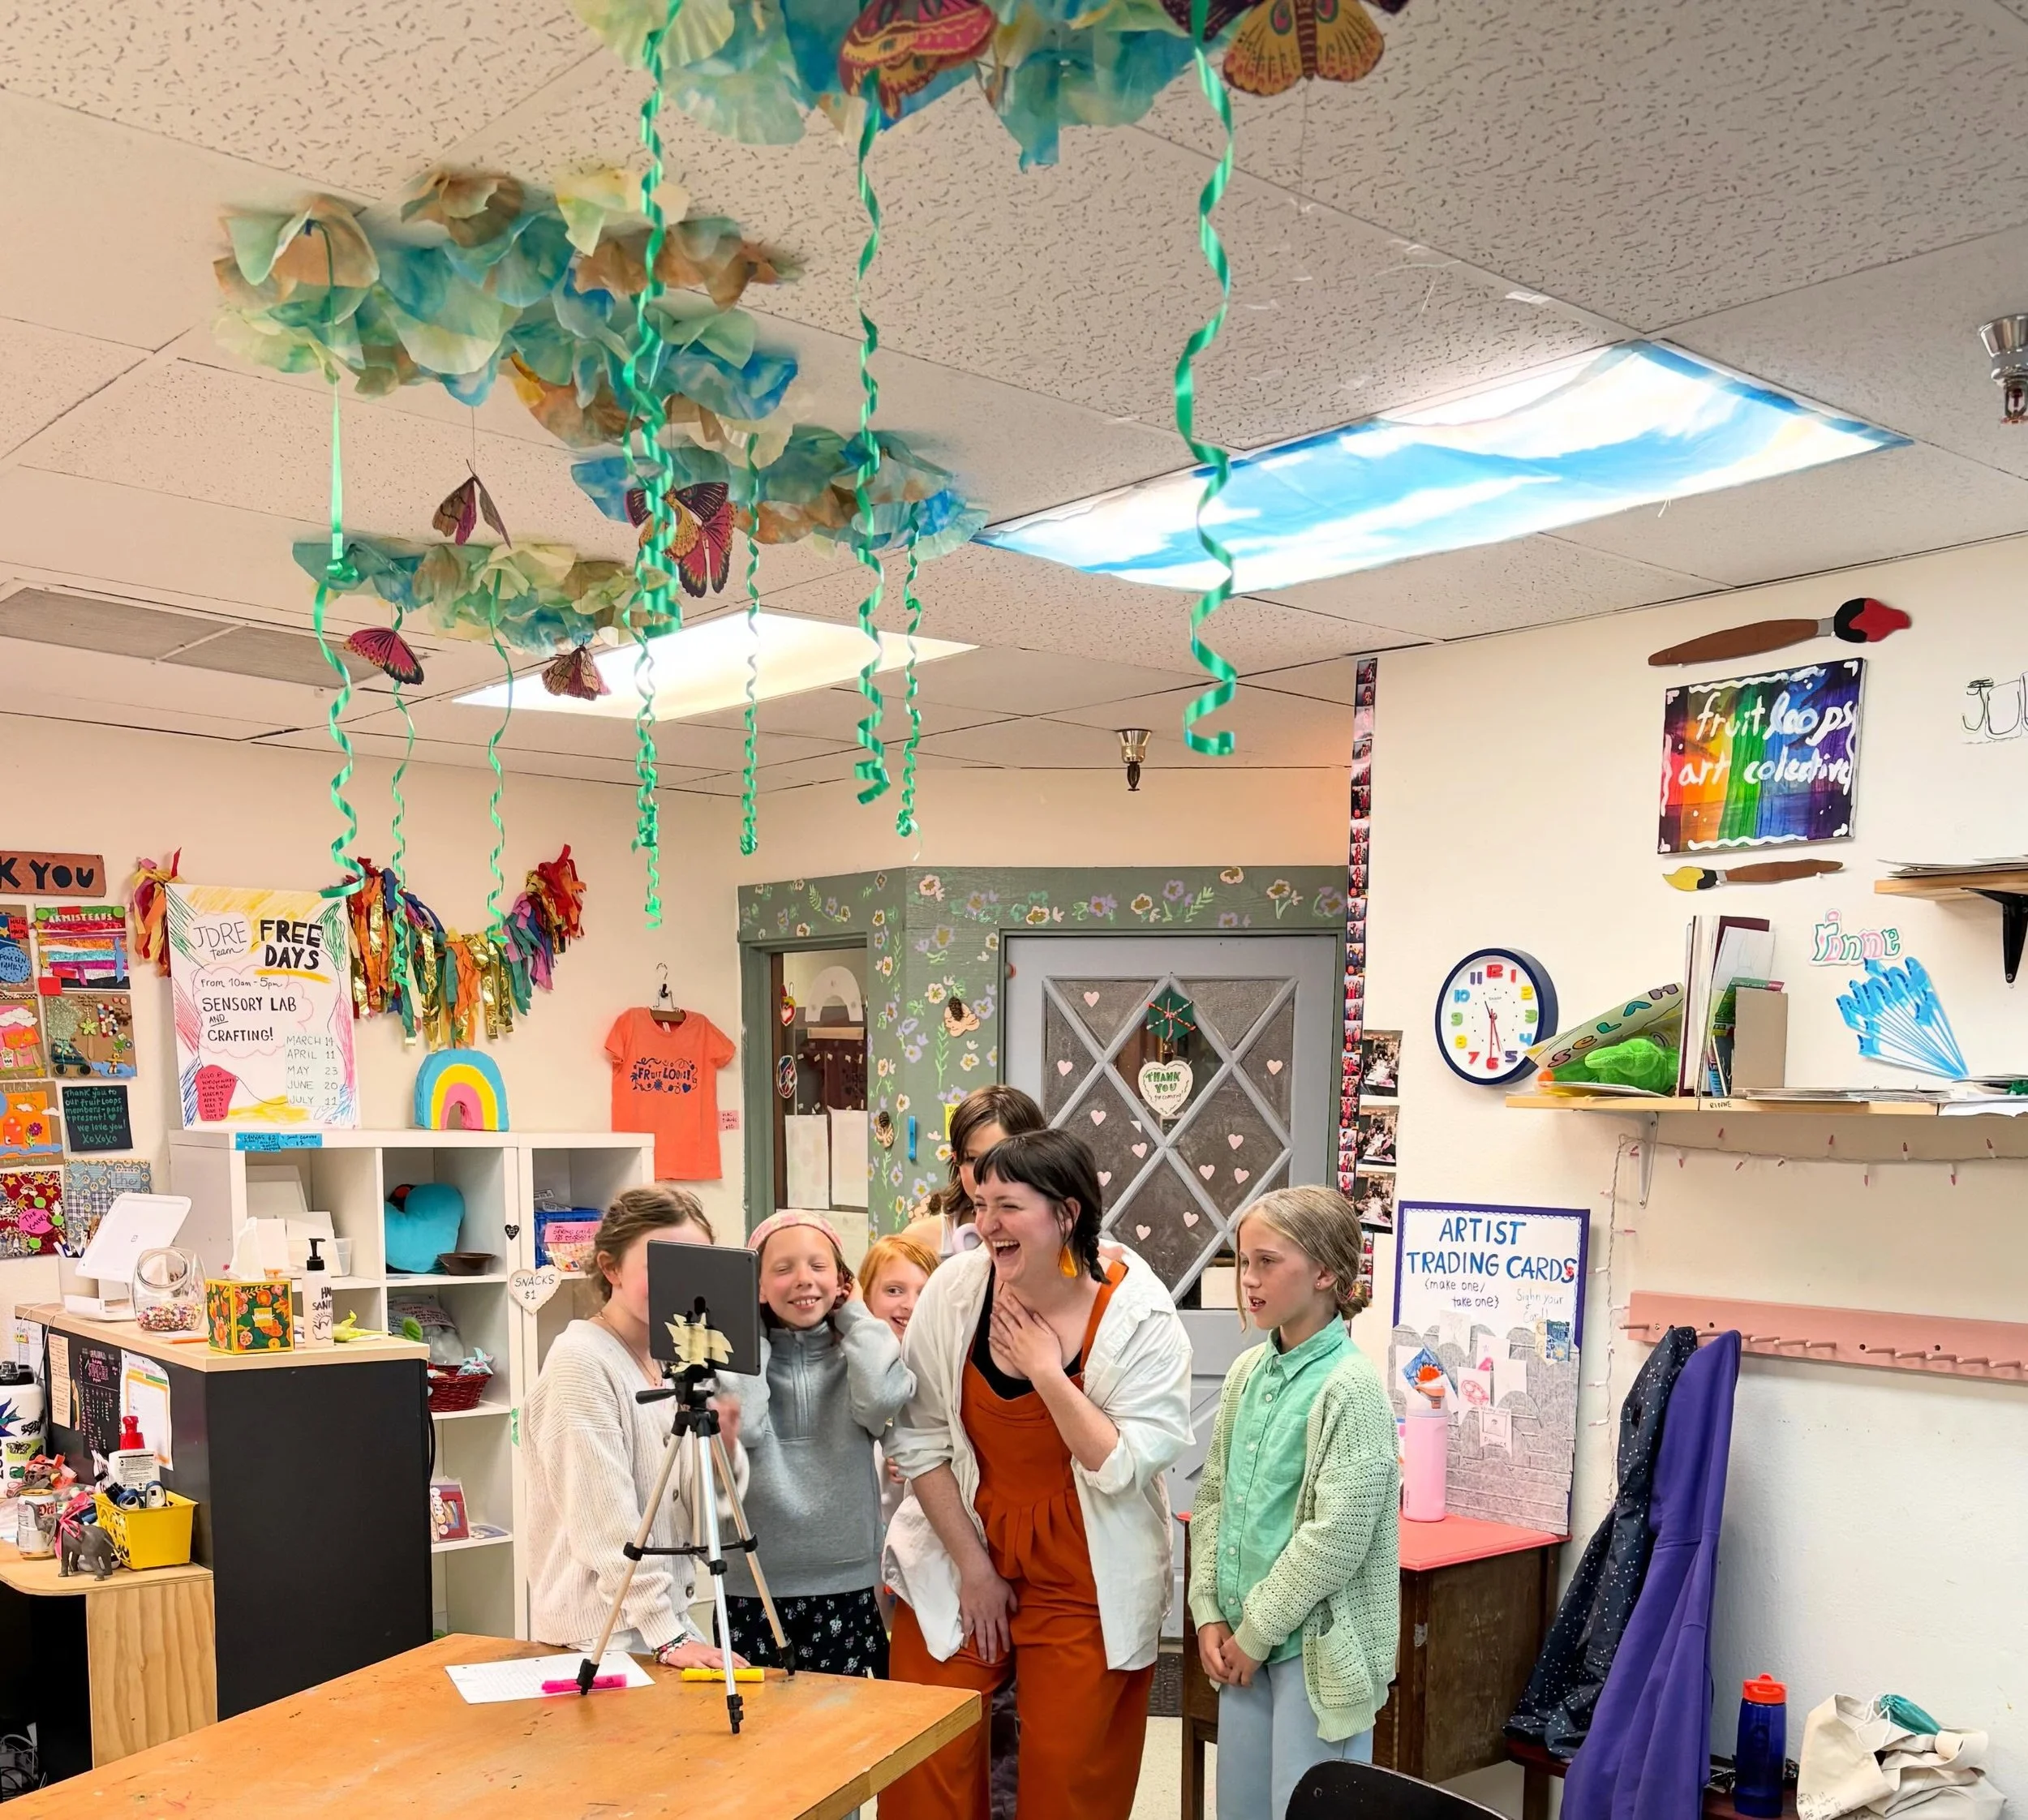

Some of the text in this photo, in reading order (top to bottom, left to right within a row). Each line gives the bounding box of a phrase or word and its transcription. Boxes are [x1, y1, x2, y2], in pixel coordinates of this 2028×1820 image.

[1695, 690, 1854, 746] fruit loops
[1678, 750, 1730, 786] art
[29, 858, 94, 890] YOU
[193, 919, 323, 948] JDRE FREE
[264, 944, 320, 970] DAYS
[1486, 964, 1503, 978] 12
[1510, 969, 1516, 983] 1
[1470, 972, 1483, 985] 11
[1454, 989, 1470, 1003] 10
[1520, 985, 1533, 1000] 2
[202, 997, 297, 1012] SENSORY LAB
[208, 1014, 226, 1024] AND
[1451, 1012, 1463, 1026] 9
[1524, 1009, 1538, 1024] 3
[208, 1027, 274, 1042] CRAFTING!
[286, 1036, 321, 1046] MARCH
[1519, 1033, 1532, 1046] 4
[1454, 1035, 1467, 1049] 8
[287, 1050, 335, 1060] APRIL 11
[1468, 1051, 1480, 1064] 7
[1505, 1050, 1518, 1063] 5
[1486, 1057, 1499, 1070] 6
[287, 1066, 338, 1076] MAY 23
[1145, 1071, 1181, 1082] THANK
[287, 1080, 314, 1090] JUNE
[1155, 1083, 1177, 1093] YOU
[64, 1088, 91, 1097] Thank
[92, 1089, 107, 1098] you
[65, 1098, 79, 1106] our
[289, 1095, 314, 1105] JULY
[1709, 1101, 1732, 1109] RINNE
[92, 1123, 108, 1131] love
[109, 1119, 126, 1133] you!
[1438, 1217, 1527, 1245] ARTIST
[1406, 1251, 1578, 1284] TRADING CARDS
[514, 1273, 556, 1288] SNACKS
[524, 1290, 537, 1300] $1
[1544, 1294, 1563, 1304] your
[1451, 1297, 1472, 1308] take
